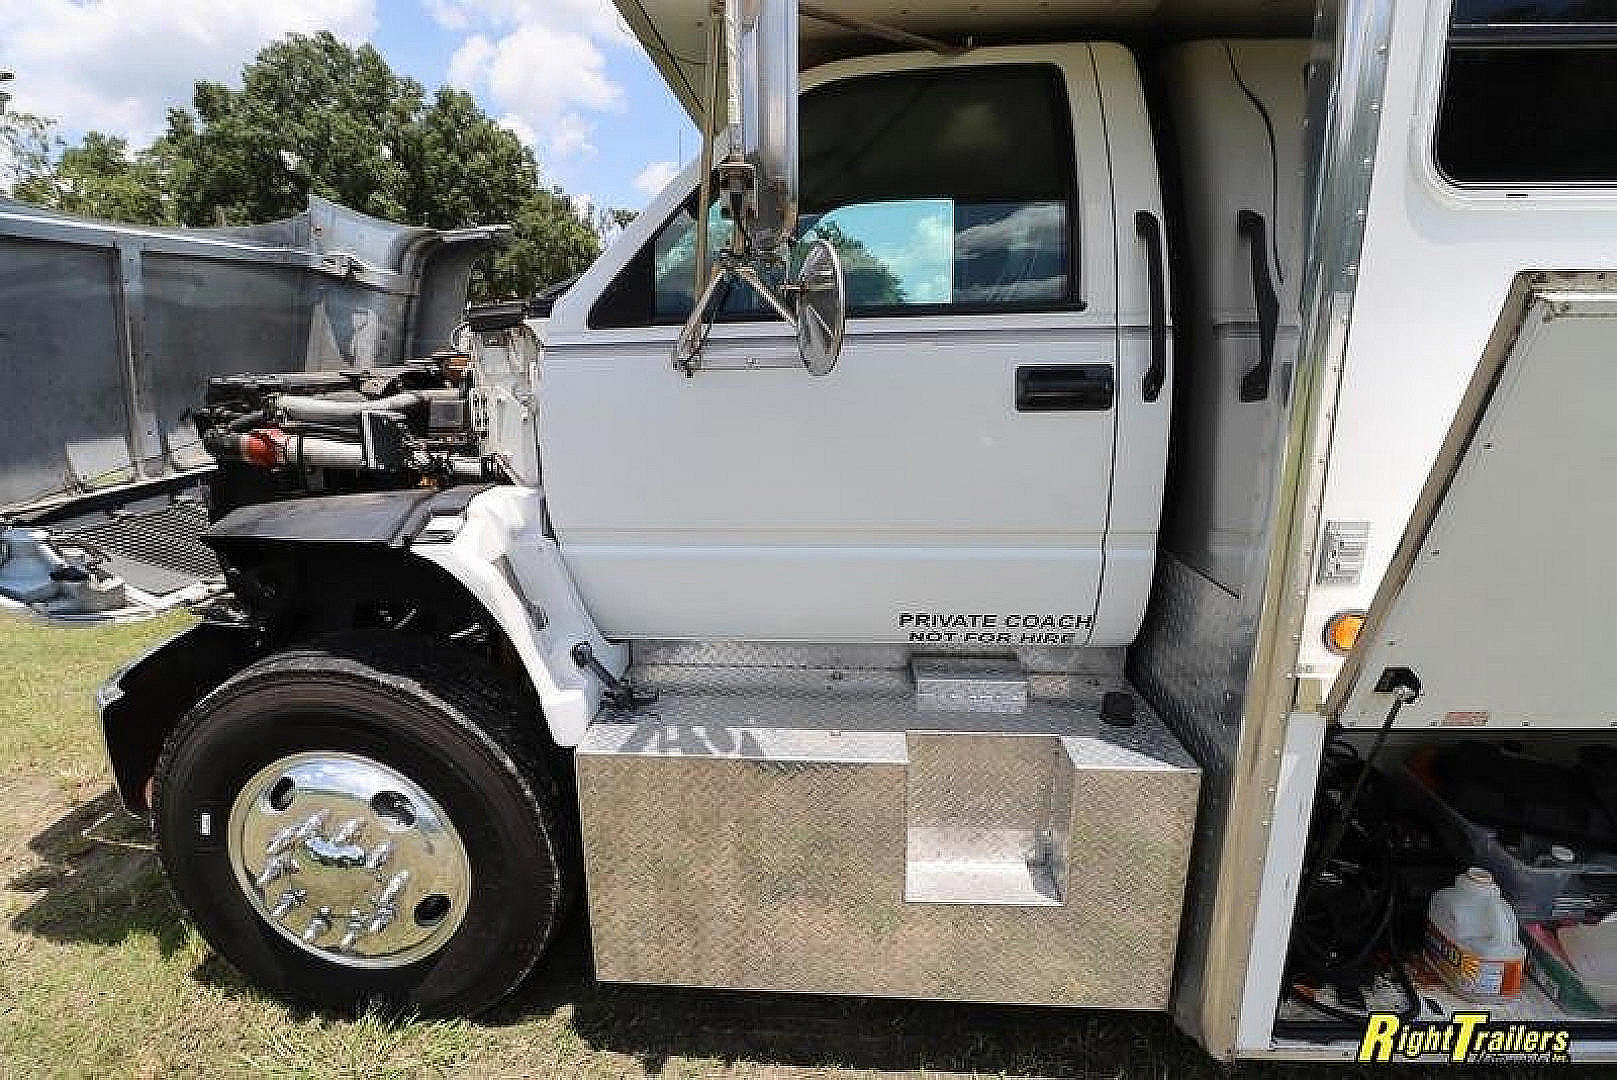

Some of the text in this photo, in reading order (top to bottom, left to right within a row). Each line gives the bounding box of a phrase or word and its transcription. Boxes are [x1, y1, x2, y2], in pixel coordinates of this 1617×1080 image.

[898, 613, 1093, 629] PRIVATE COACH
[908, 631, 1077, 645] NOT FOR HIRE
